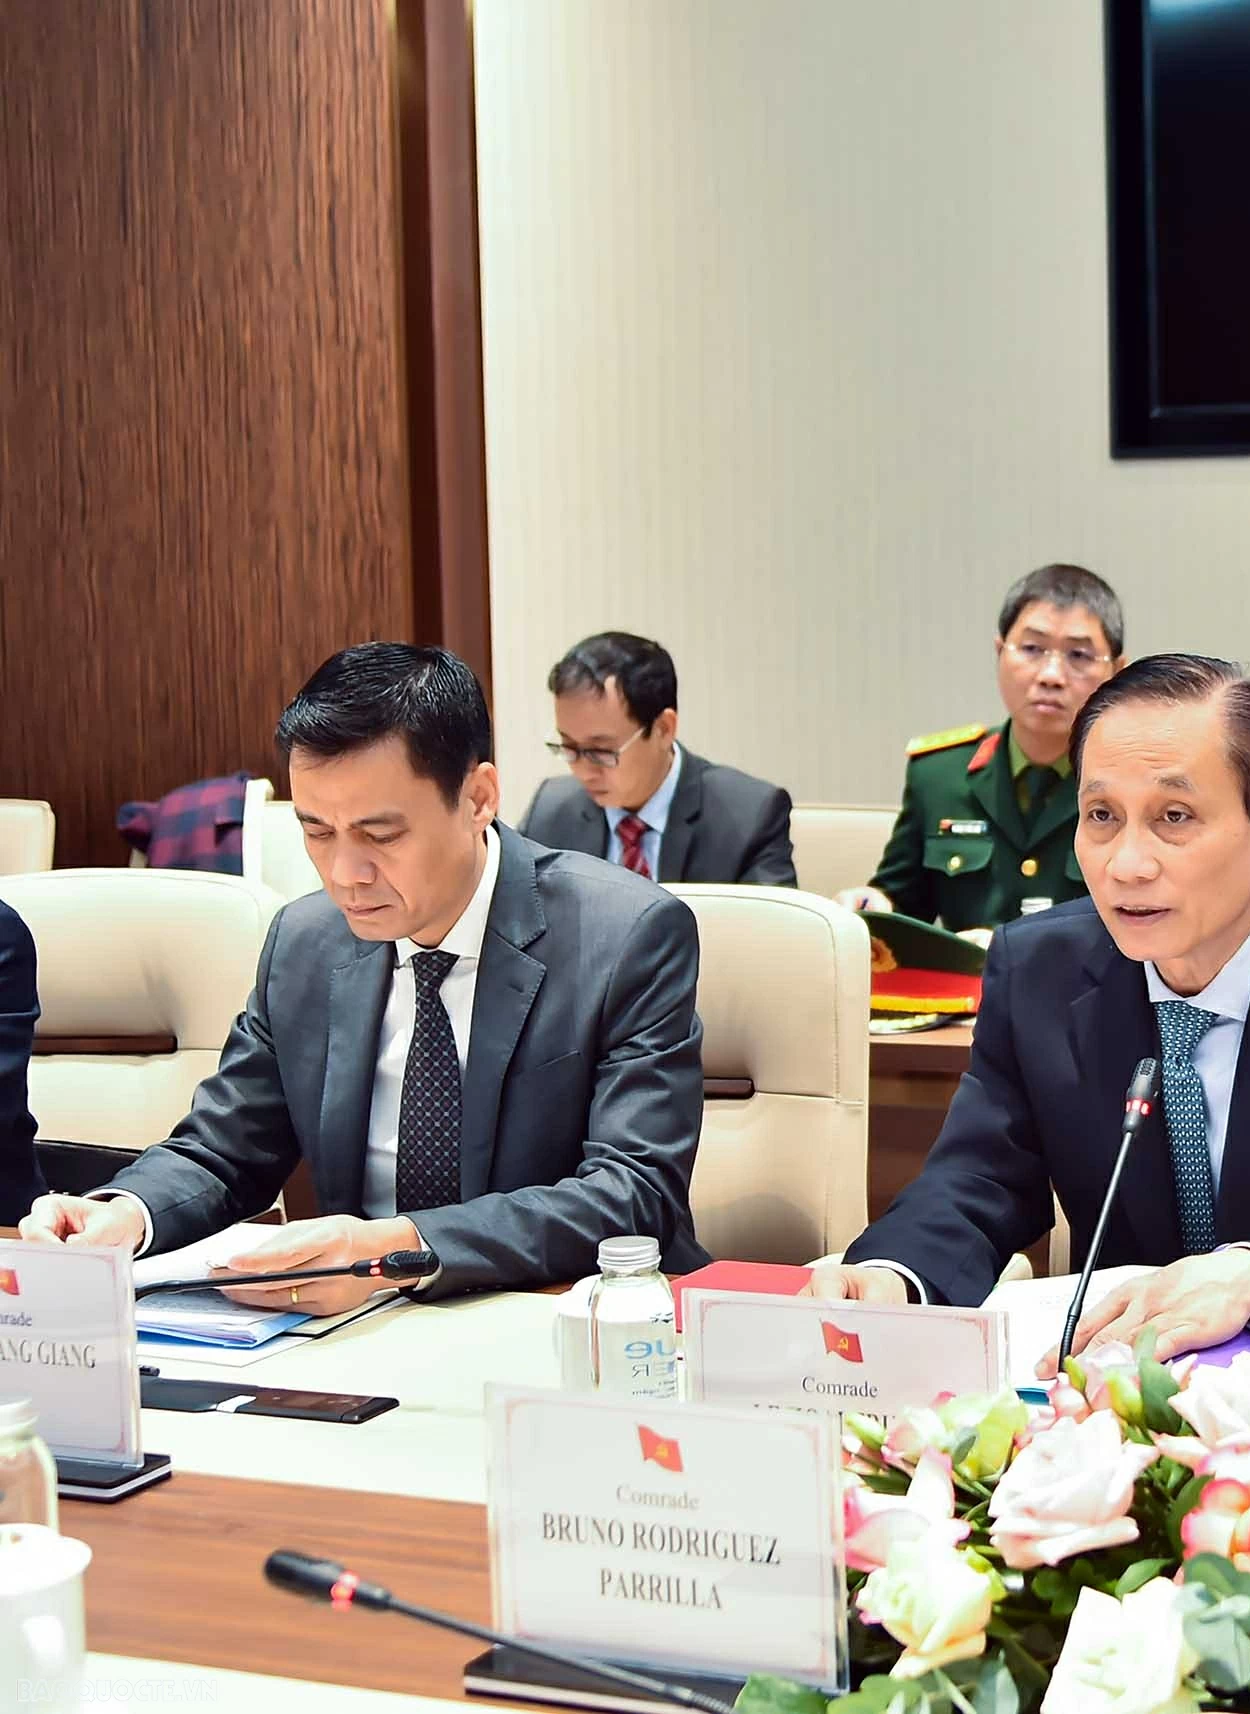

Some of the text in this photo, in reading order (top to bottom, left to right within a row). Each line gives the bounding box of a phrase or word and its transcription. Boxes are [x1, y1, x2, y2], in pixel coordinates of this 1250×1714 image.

[37, 1340, 97, 1370] GIANG
[801, 1375, 879, 1399] Comrade
[616, 1483, 701, 1511] Comrade
[542, 1511, 782, 1566] BRUNO RODRIGUEZ
[600, 1567, 722, 1610] PARRILLA
